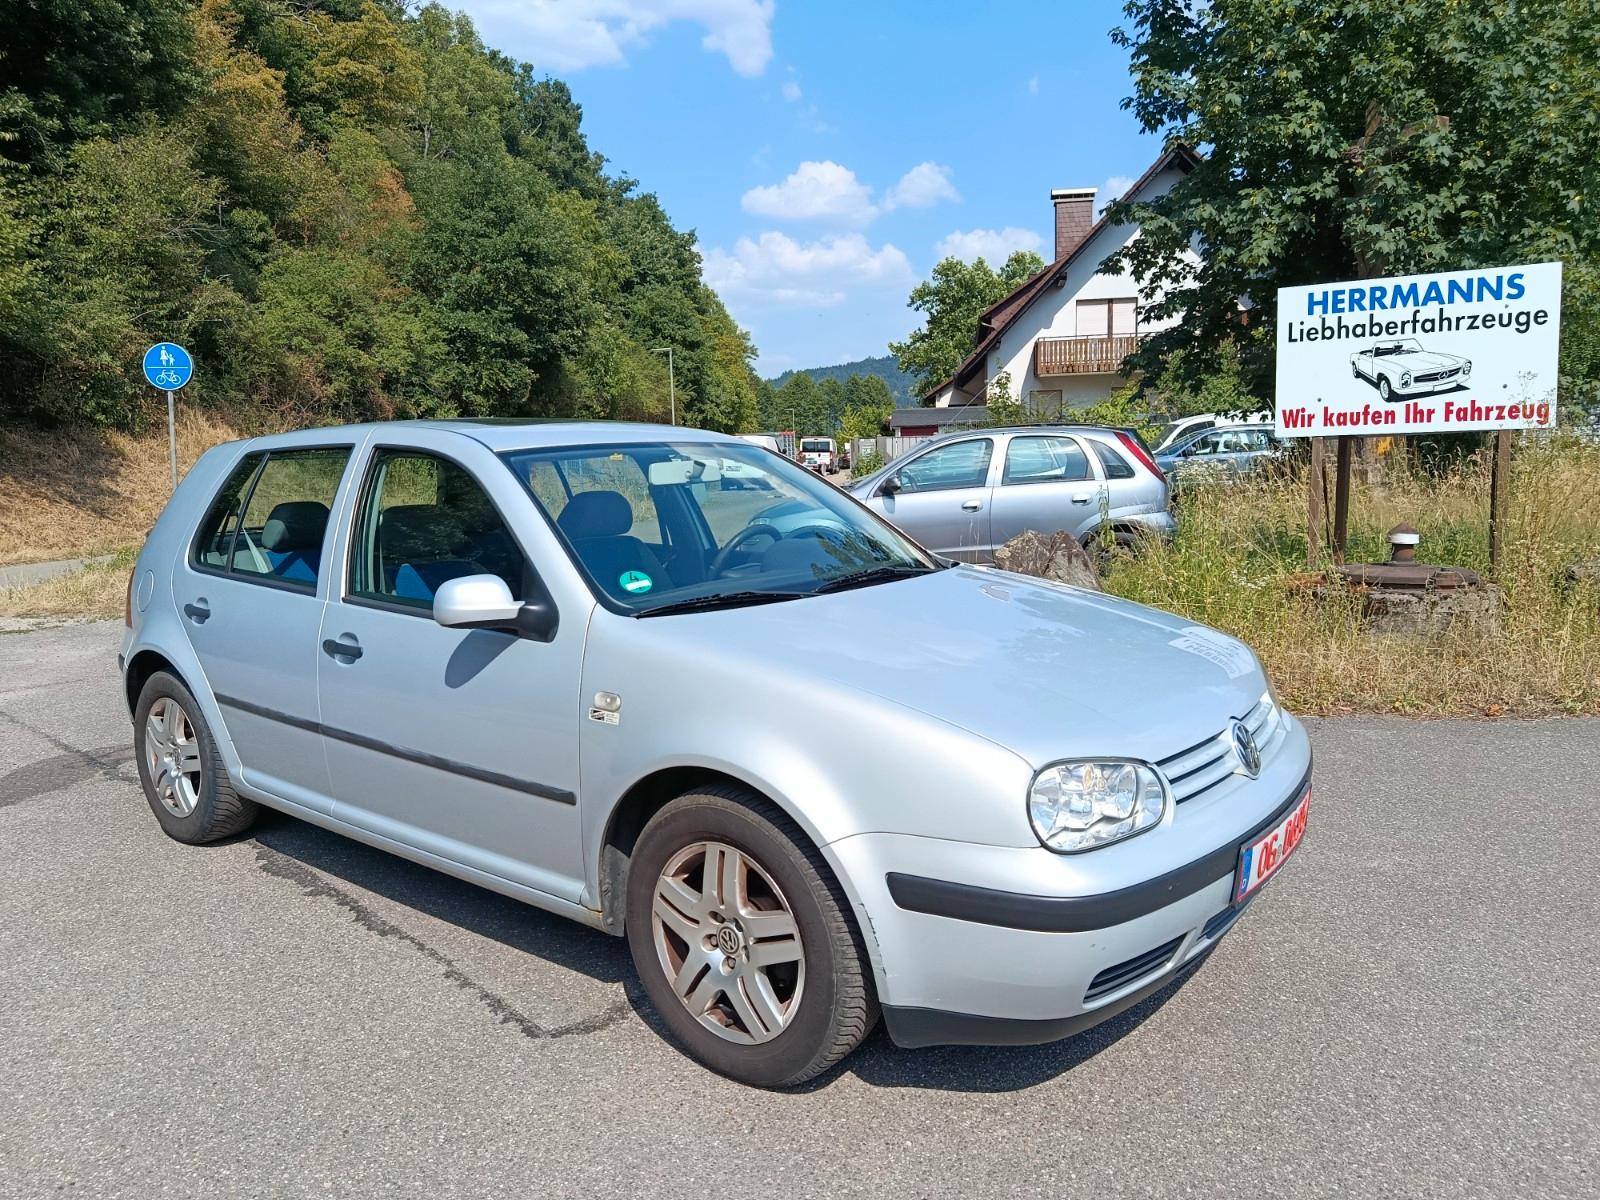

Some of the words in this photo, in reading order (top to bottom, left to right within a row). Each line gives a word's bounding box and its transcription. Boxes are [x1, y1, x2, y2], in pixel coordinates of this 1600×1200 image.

[1307, 273, 1525, 316] HERRMANNS
[1288, 308, 1549, 343] Liebhaberfahrzeuge
[1282, 407, 1316, 429] Wir
[1323, 403, 1396, 427] kaufen
[1405, 402, 1436, 424] Ihr
[1444, 399, 1550, 425] Fahrzeug
